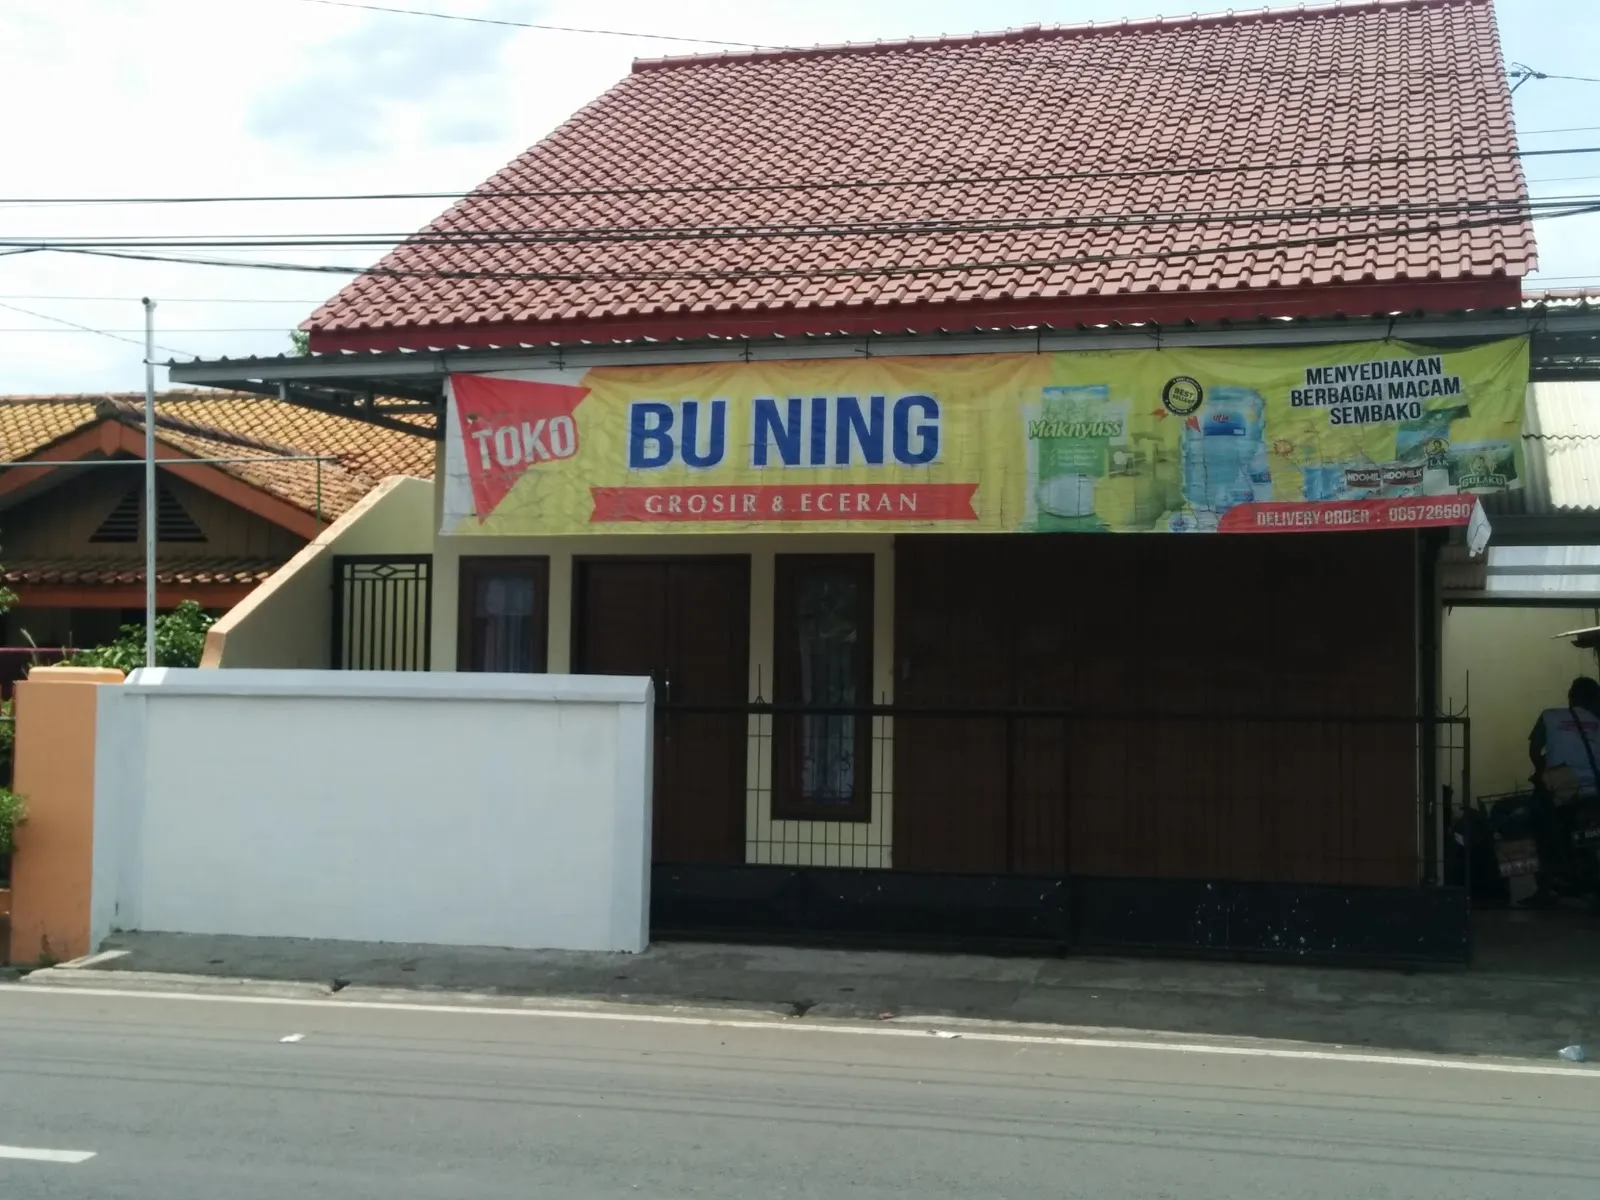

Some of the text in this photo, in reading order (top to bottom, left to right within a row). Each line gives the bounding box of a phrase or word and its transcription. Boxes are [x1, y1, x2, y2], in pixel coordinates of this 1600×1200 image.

[1306, 357, 1442, 386] MENYEDIAKAN
[1174, 387, 1194, 399] BEST
[1291, 376, 1461, 407] BERBAGAI MACAM
[1330, 402, 1422, 425] SEMBAKO
[629, 395, 940, 468] BU NING
[1028, 418, 1123, 440] Maknyuss
[471, 415, 577, 470] TOKO
[645, 493, 918, 514] GROSIR & ECERAN
[1257, 511, 1320, 526] DELIVERY
[1324, 509, 1370, 524] ORDER
